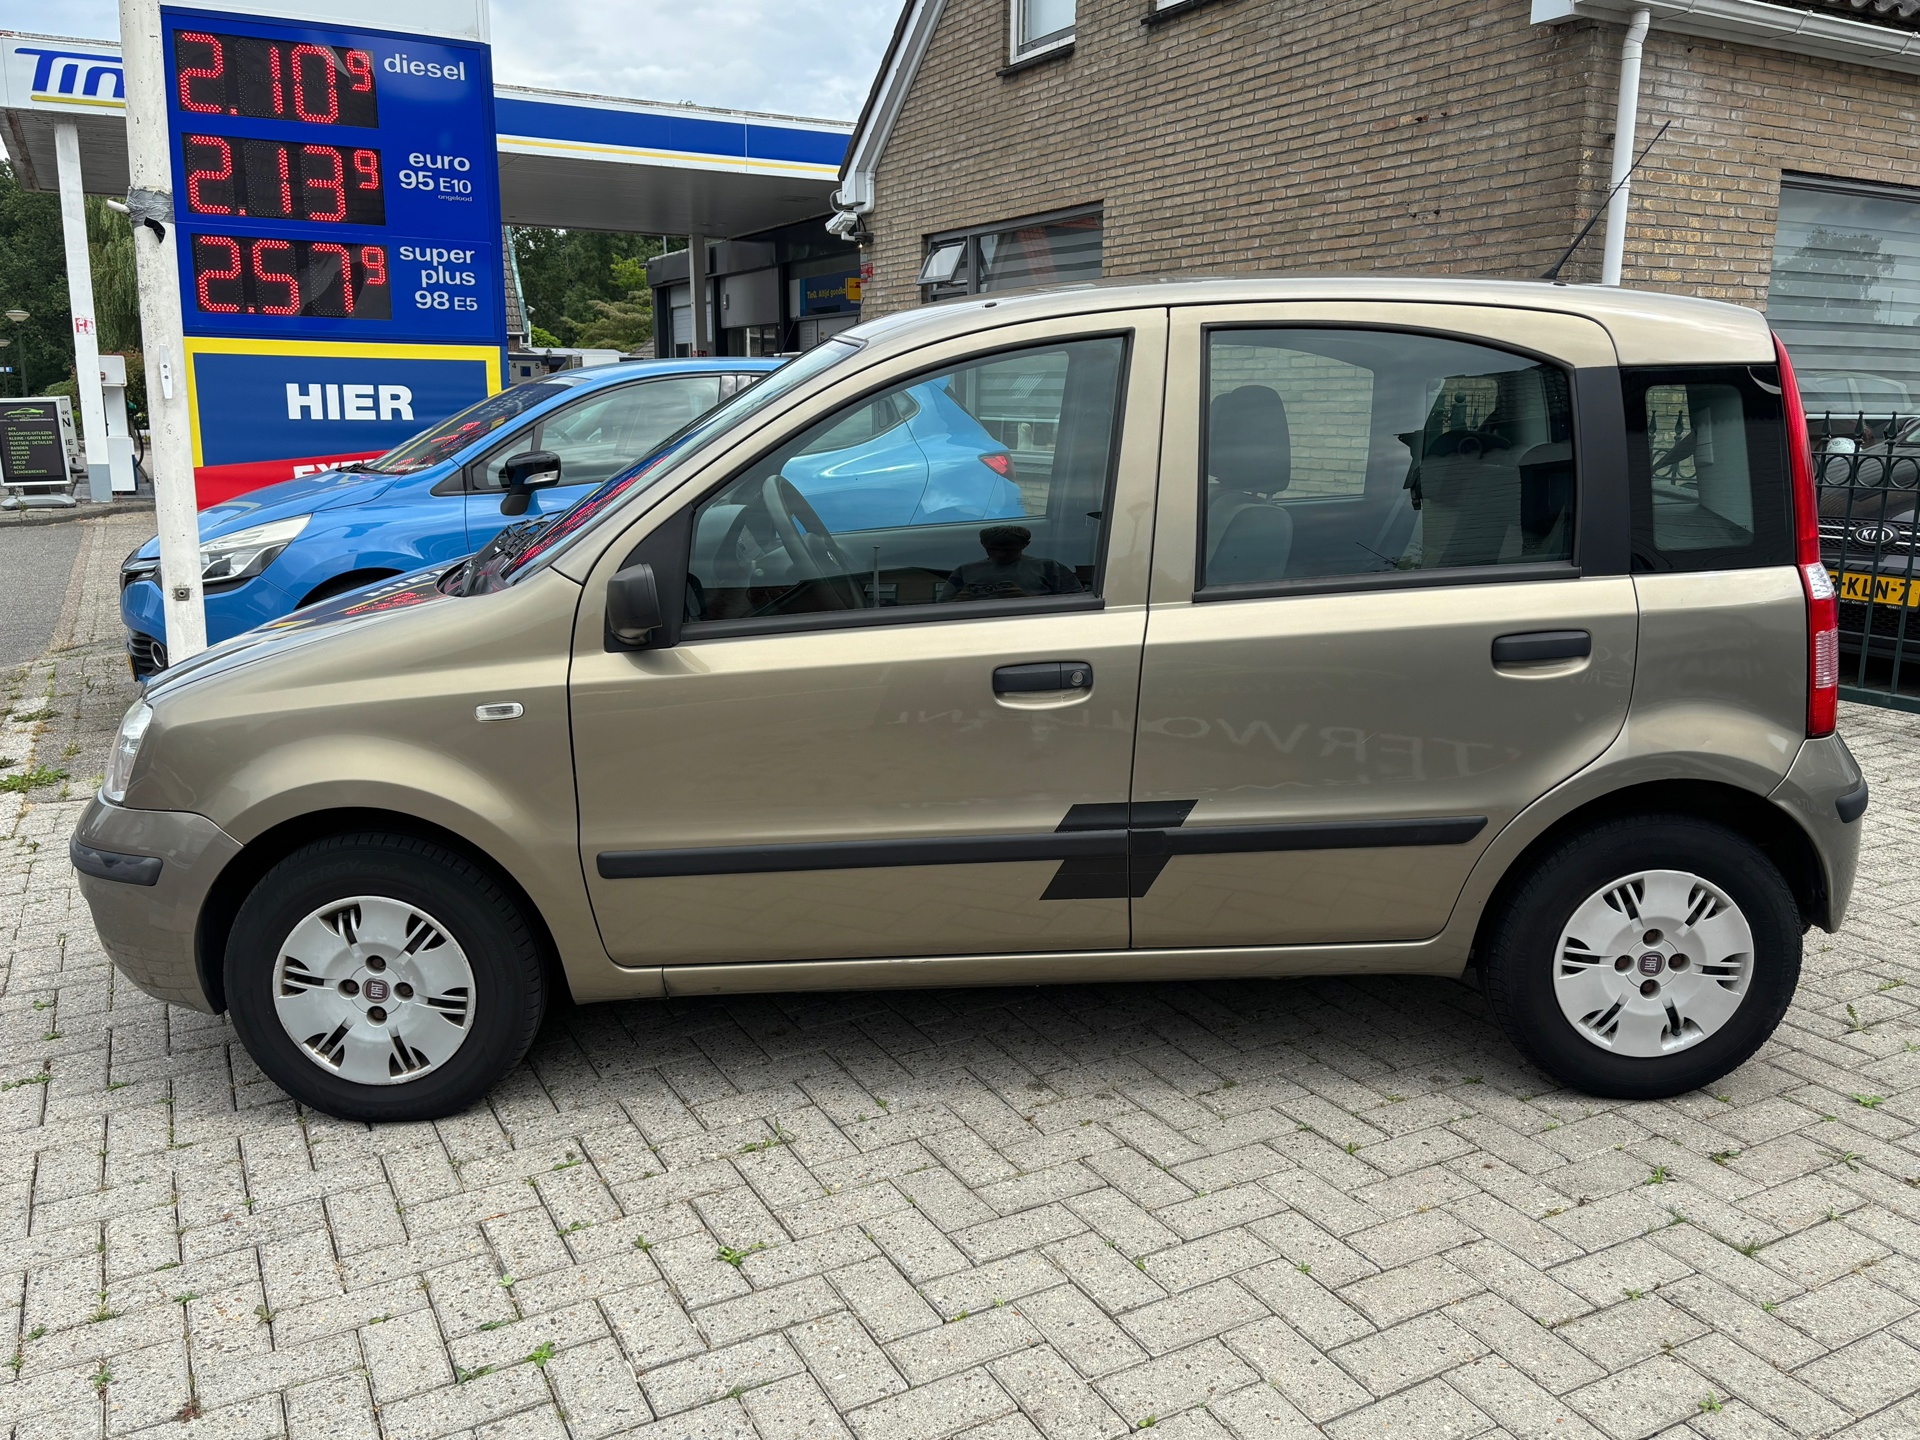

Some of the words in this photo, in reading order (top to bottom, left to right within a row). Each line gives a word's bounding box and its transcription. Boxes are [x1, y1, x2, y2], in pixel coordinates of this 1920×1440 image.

[14, 47, 125, 98] Tin
[384, 53, 466, 81] diesel
[408, 152, 471, 172] euro
[399, 169, 435, 191] 95
[440, 177, 472, 194] E10
[399, 245, 475, 266] super
[420, 266, 476, 287] plus
[414, 290, 450, 310] 98
[454, 297, 478, 311] E5
[535, 362, 540, 370] 5
[286, 383, 415, 420] HIER
[1644, 956, 1658, 972] FIAT
[371, 982, 384, 998] FIAT
